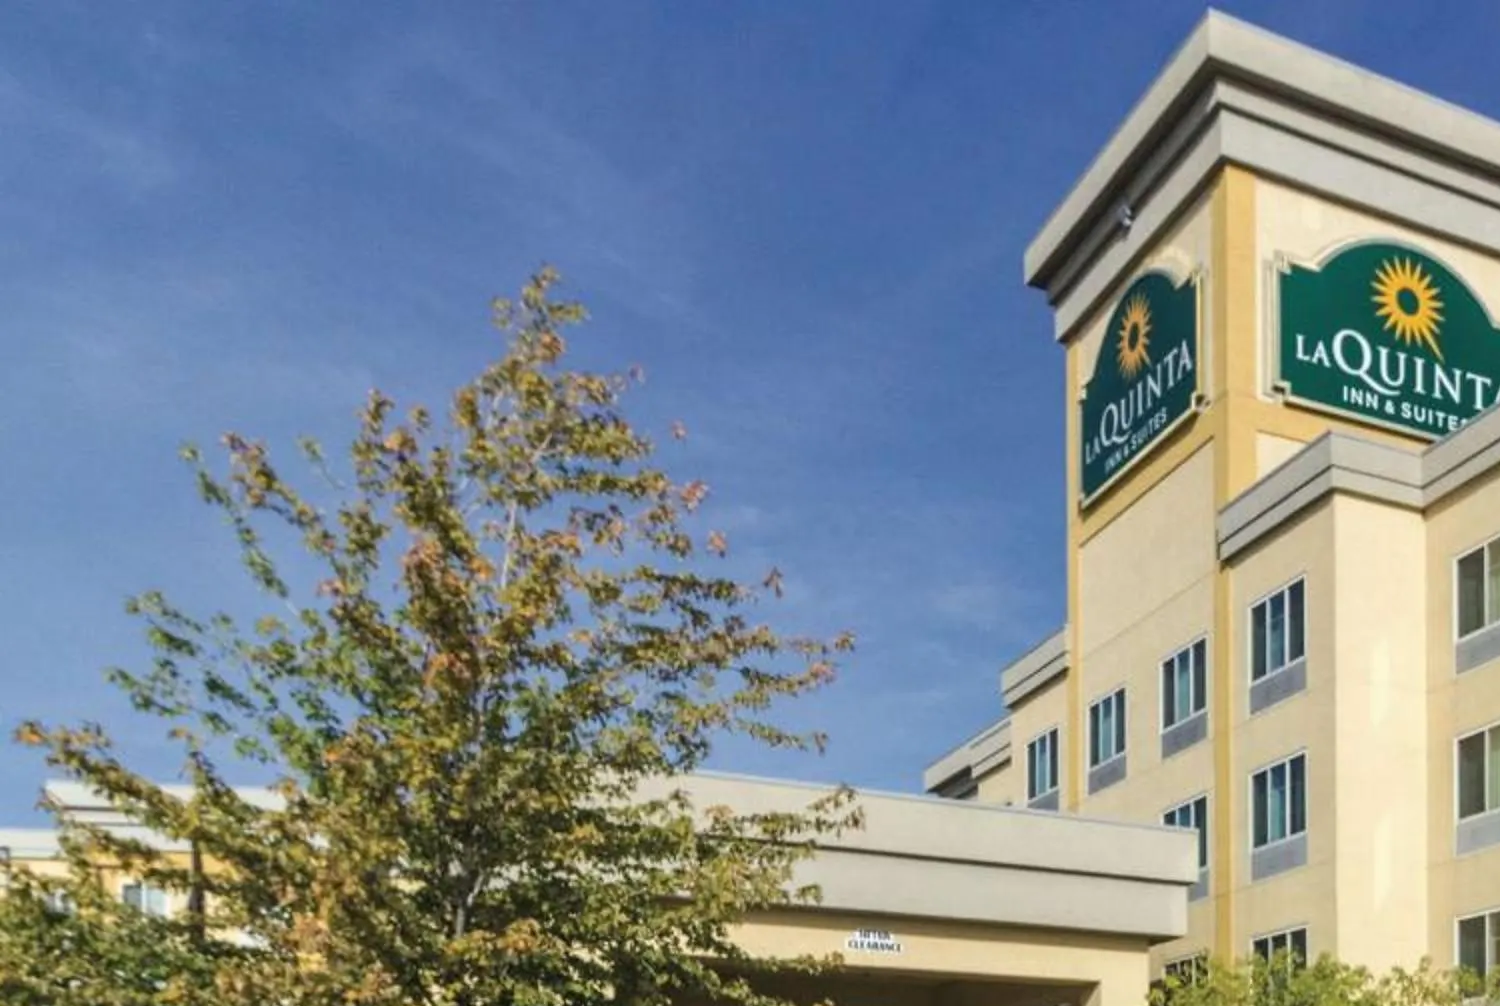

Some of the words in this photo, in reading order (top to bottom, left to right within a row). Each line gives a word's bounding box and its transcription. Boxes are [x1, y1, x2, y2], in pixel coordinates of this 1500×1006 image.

[1296, 334, 1331, 367] LA
[1085, 436, 1100, 464] LA
[1100, 339, 1193, 447] QUINTA
[1343, 386, 1378, 409] INN
[1385, 402, 1395, 415] &
[1131, 407, 1167, 450] SUITES
